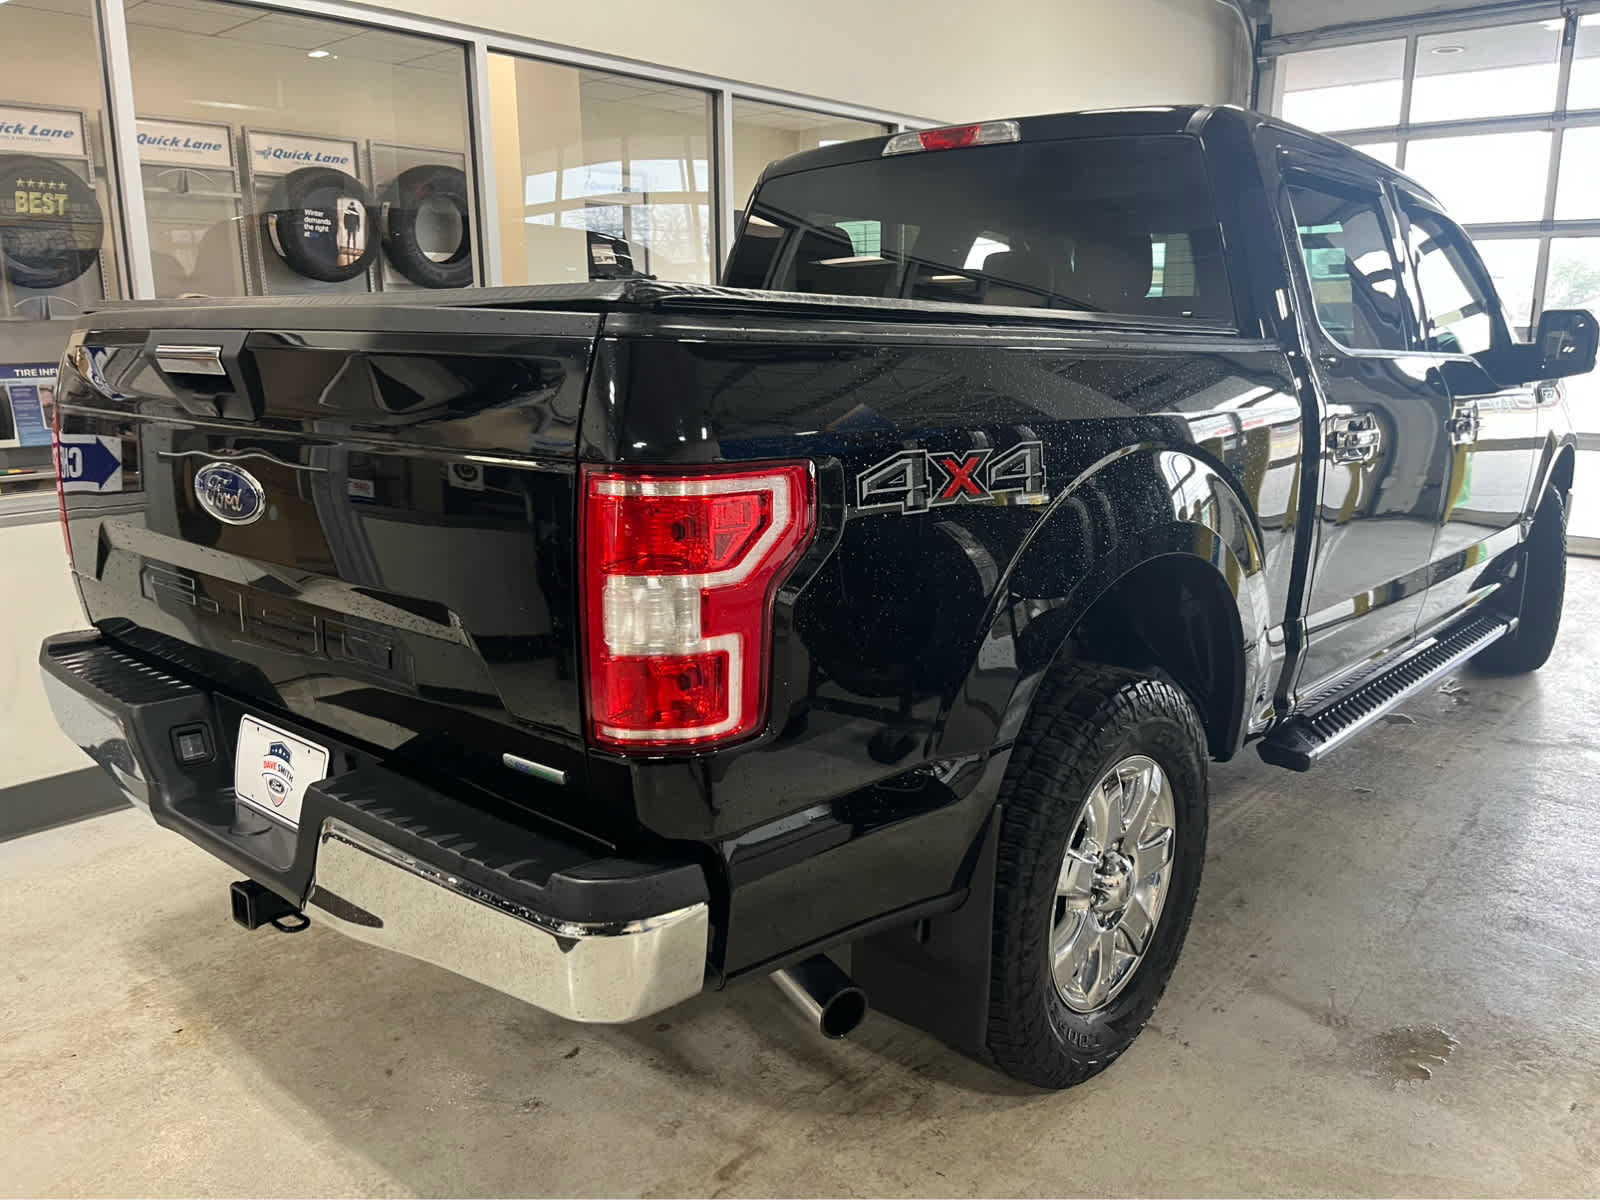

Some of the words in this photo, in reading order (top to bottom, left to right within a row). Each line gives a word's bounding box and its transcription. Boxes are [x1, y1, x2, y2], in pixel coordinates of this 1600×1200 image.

[28, 125, 75, 138] Lane
[136, 133, 180, 147] Quick
[183, 138, 222, 151] Lane
[273, 148, 312, 161] Quick
[314, 152, 349, 164] Lane
[15, 190, 69, 216] BEST
[304, 209, 324, 217] Winter
[304, 216, 332, 225] demands
[14, 368, 38, 377] TIRE
[206, 474, 243, 511] Ford
[263, 760, 277, 770] DAVE
[278, 764, 294, 782] SMITH
